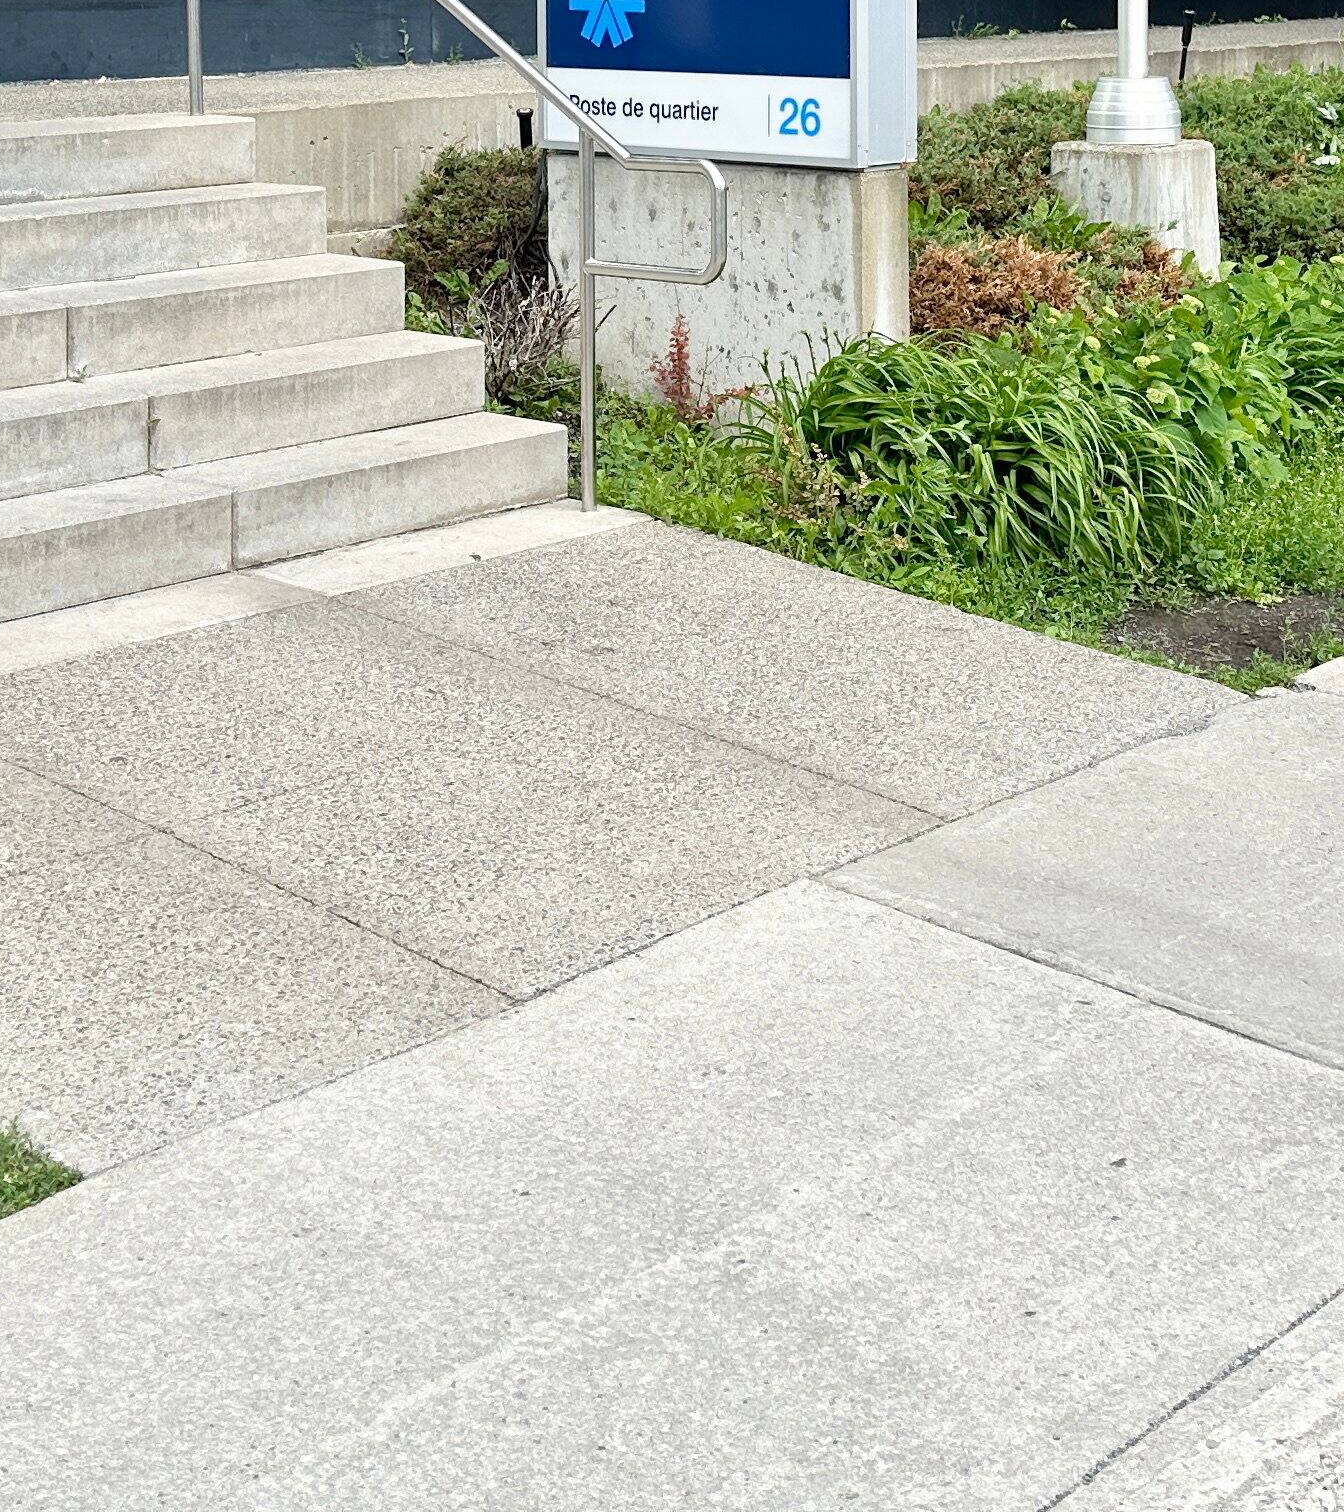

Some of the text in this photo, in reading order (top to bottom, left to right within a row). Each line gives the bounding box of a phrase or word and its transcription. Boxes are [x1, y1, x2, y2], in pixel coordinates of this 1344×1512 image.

[569, 94, 821, 137] Poste de quartier 26
